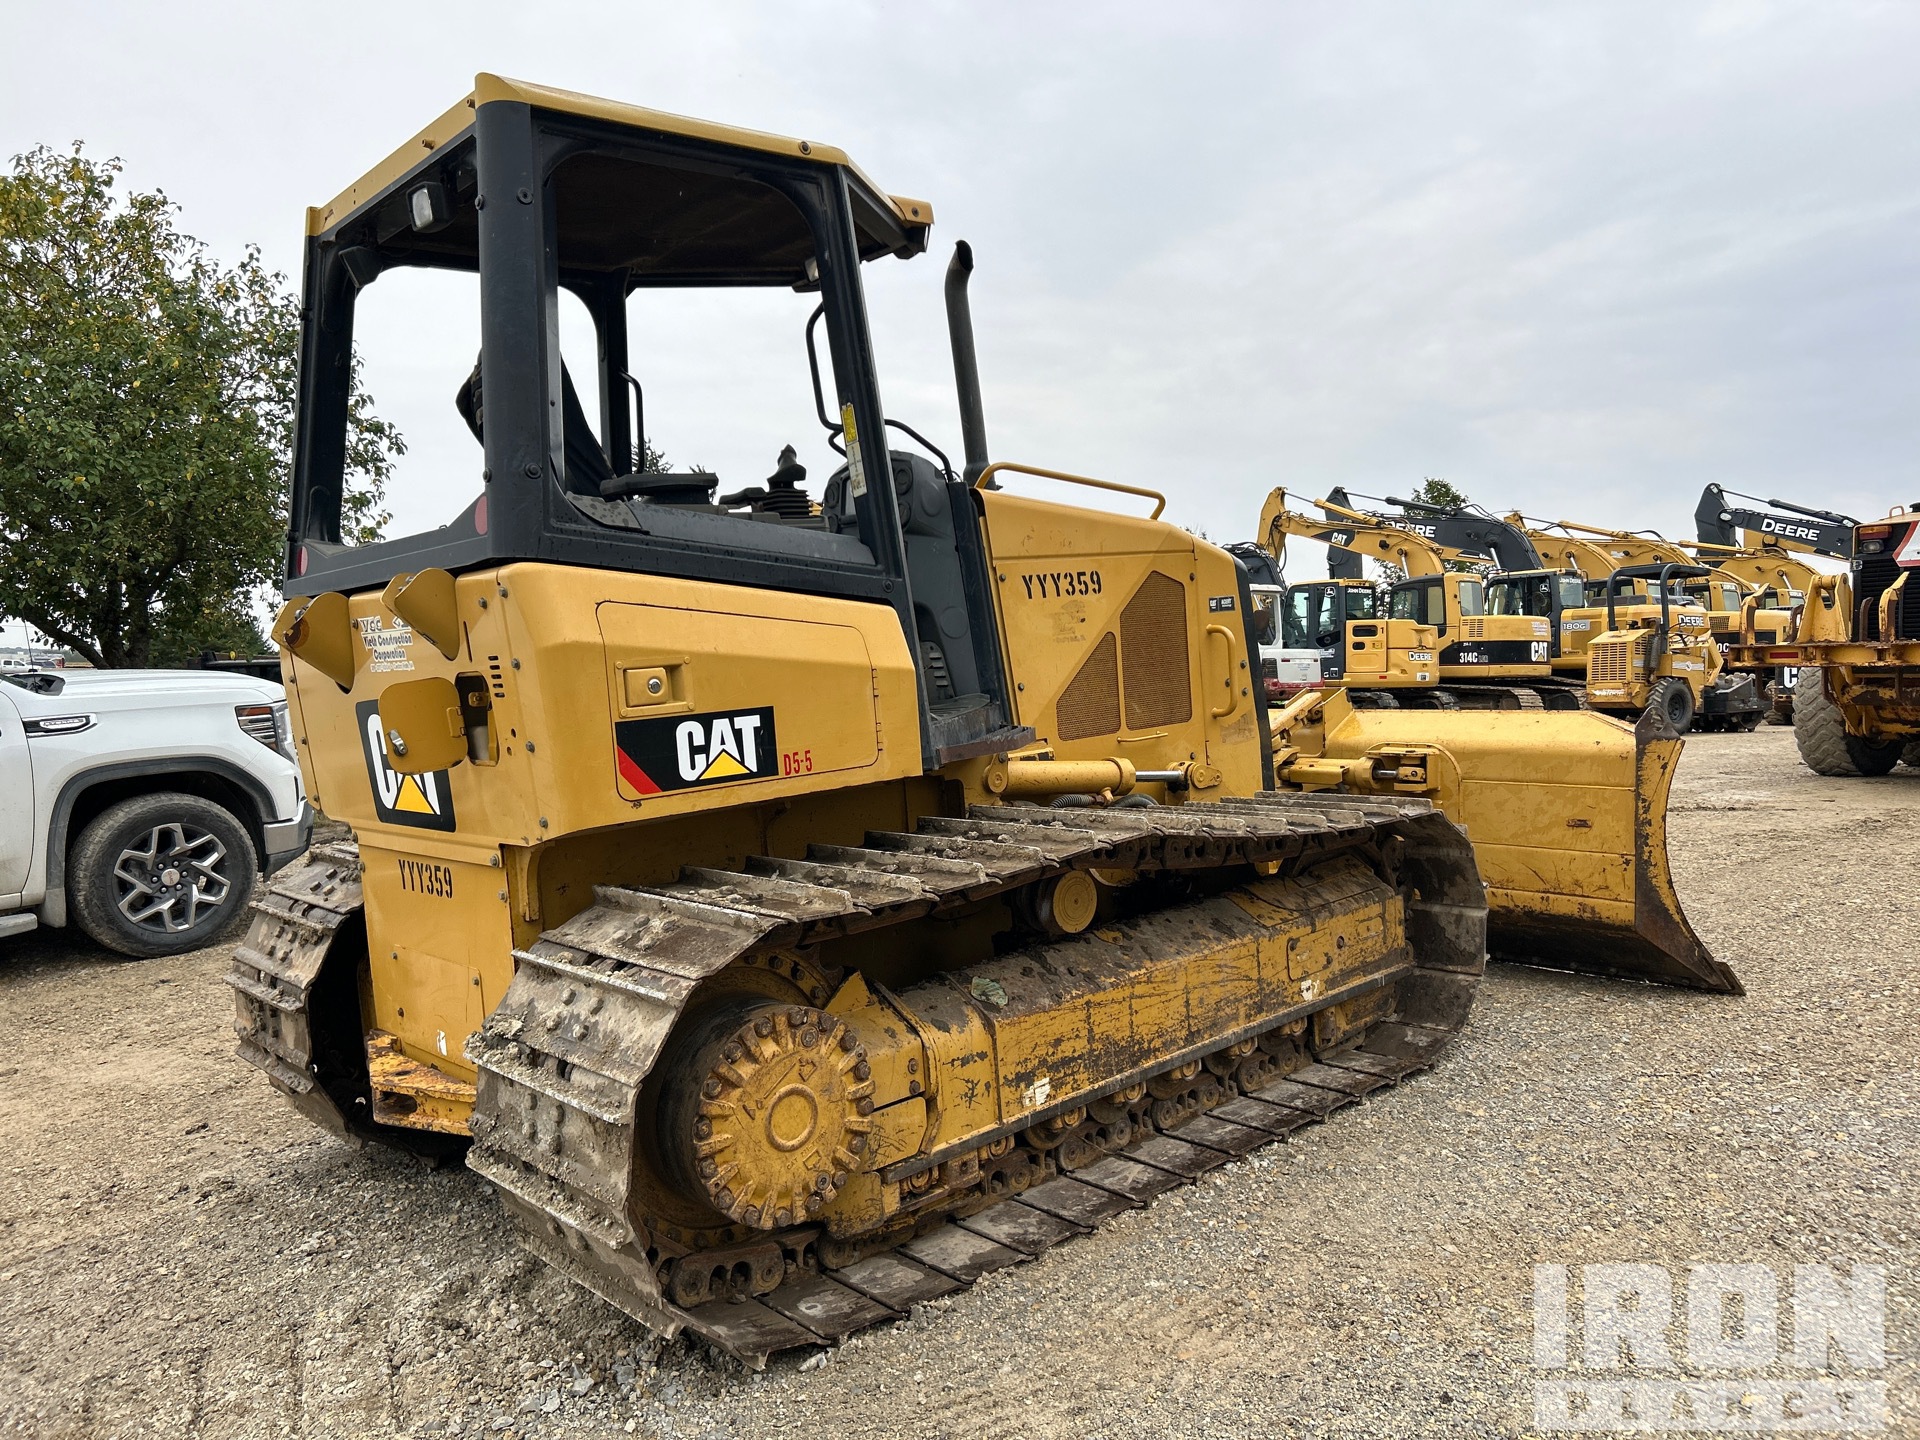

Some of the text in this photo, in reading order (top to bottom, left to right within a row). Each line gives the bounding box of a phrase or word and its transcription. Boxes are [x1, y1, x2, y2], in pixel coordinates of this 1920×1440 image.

[1760, 517, 1821, 541] DEERE
[1331, 532, 1348, 546] CAT
[1021, 570, 1103, 600] YYY359
[1562, 622, 1586, 630] 180G
[1678, 614, 1705, 627] DEERE
[377, 632, 413, 647] Construction
[373, 649, 407, 662] Corporation
[1408, 651, 1433, 661] DEERE
[1459, 652, 1478, 663] 314C
[1530, 641, 1548, 662] CAT
[675, 714, 761, 782] CAT
[782, 749, 813, 776] D5-5
[397, 858, 454, 899] YYY359
